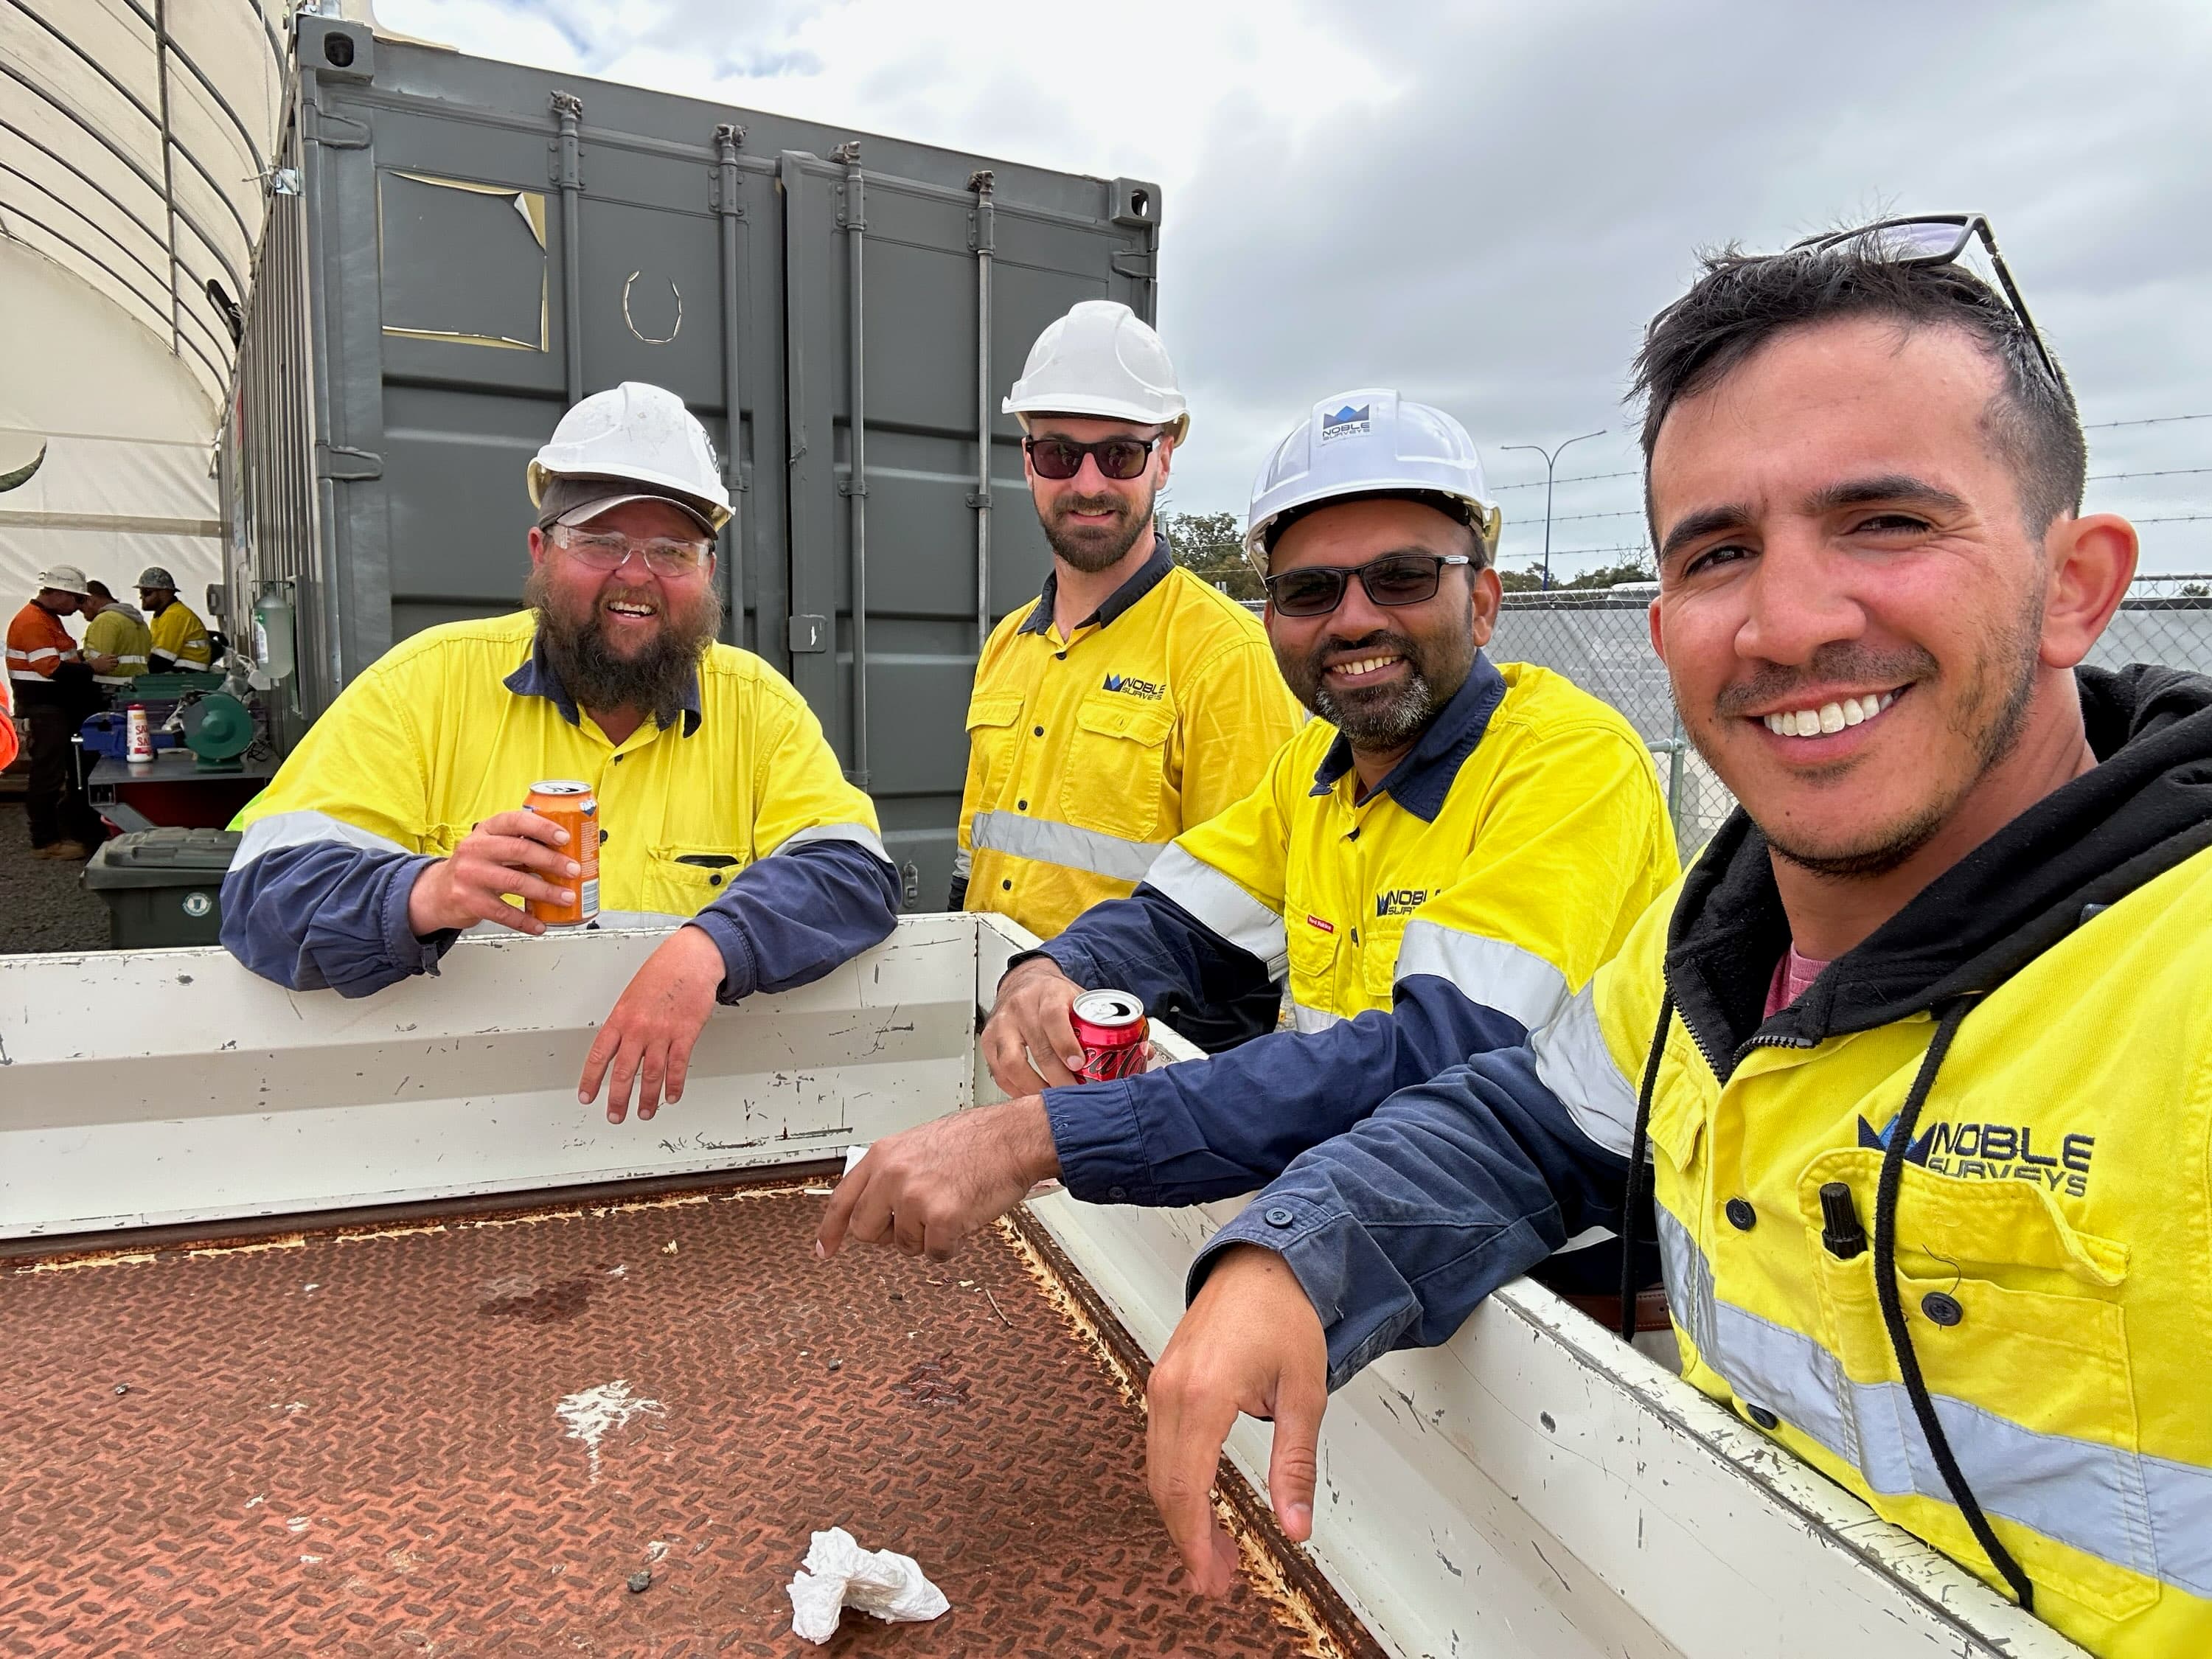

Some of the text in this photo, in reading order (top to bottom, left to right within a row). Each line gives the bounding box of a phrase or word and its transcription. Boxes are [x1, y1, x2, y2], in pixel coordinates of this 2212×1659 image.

[1322, 422, 1370, 437] NOBLE
[1123, 678, 1166, 695] NOBLE
[1932, 1122, 2096, 1174] NOBLE
[1928, 1157, 2087, 1197] SURVEYS
